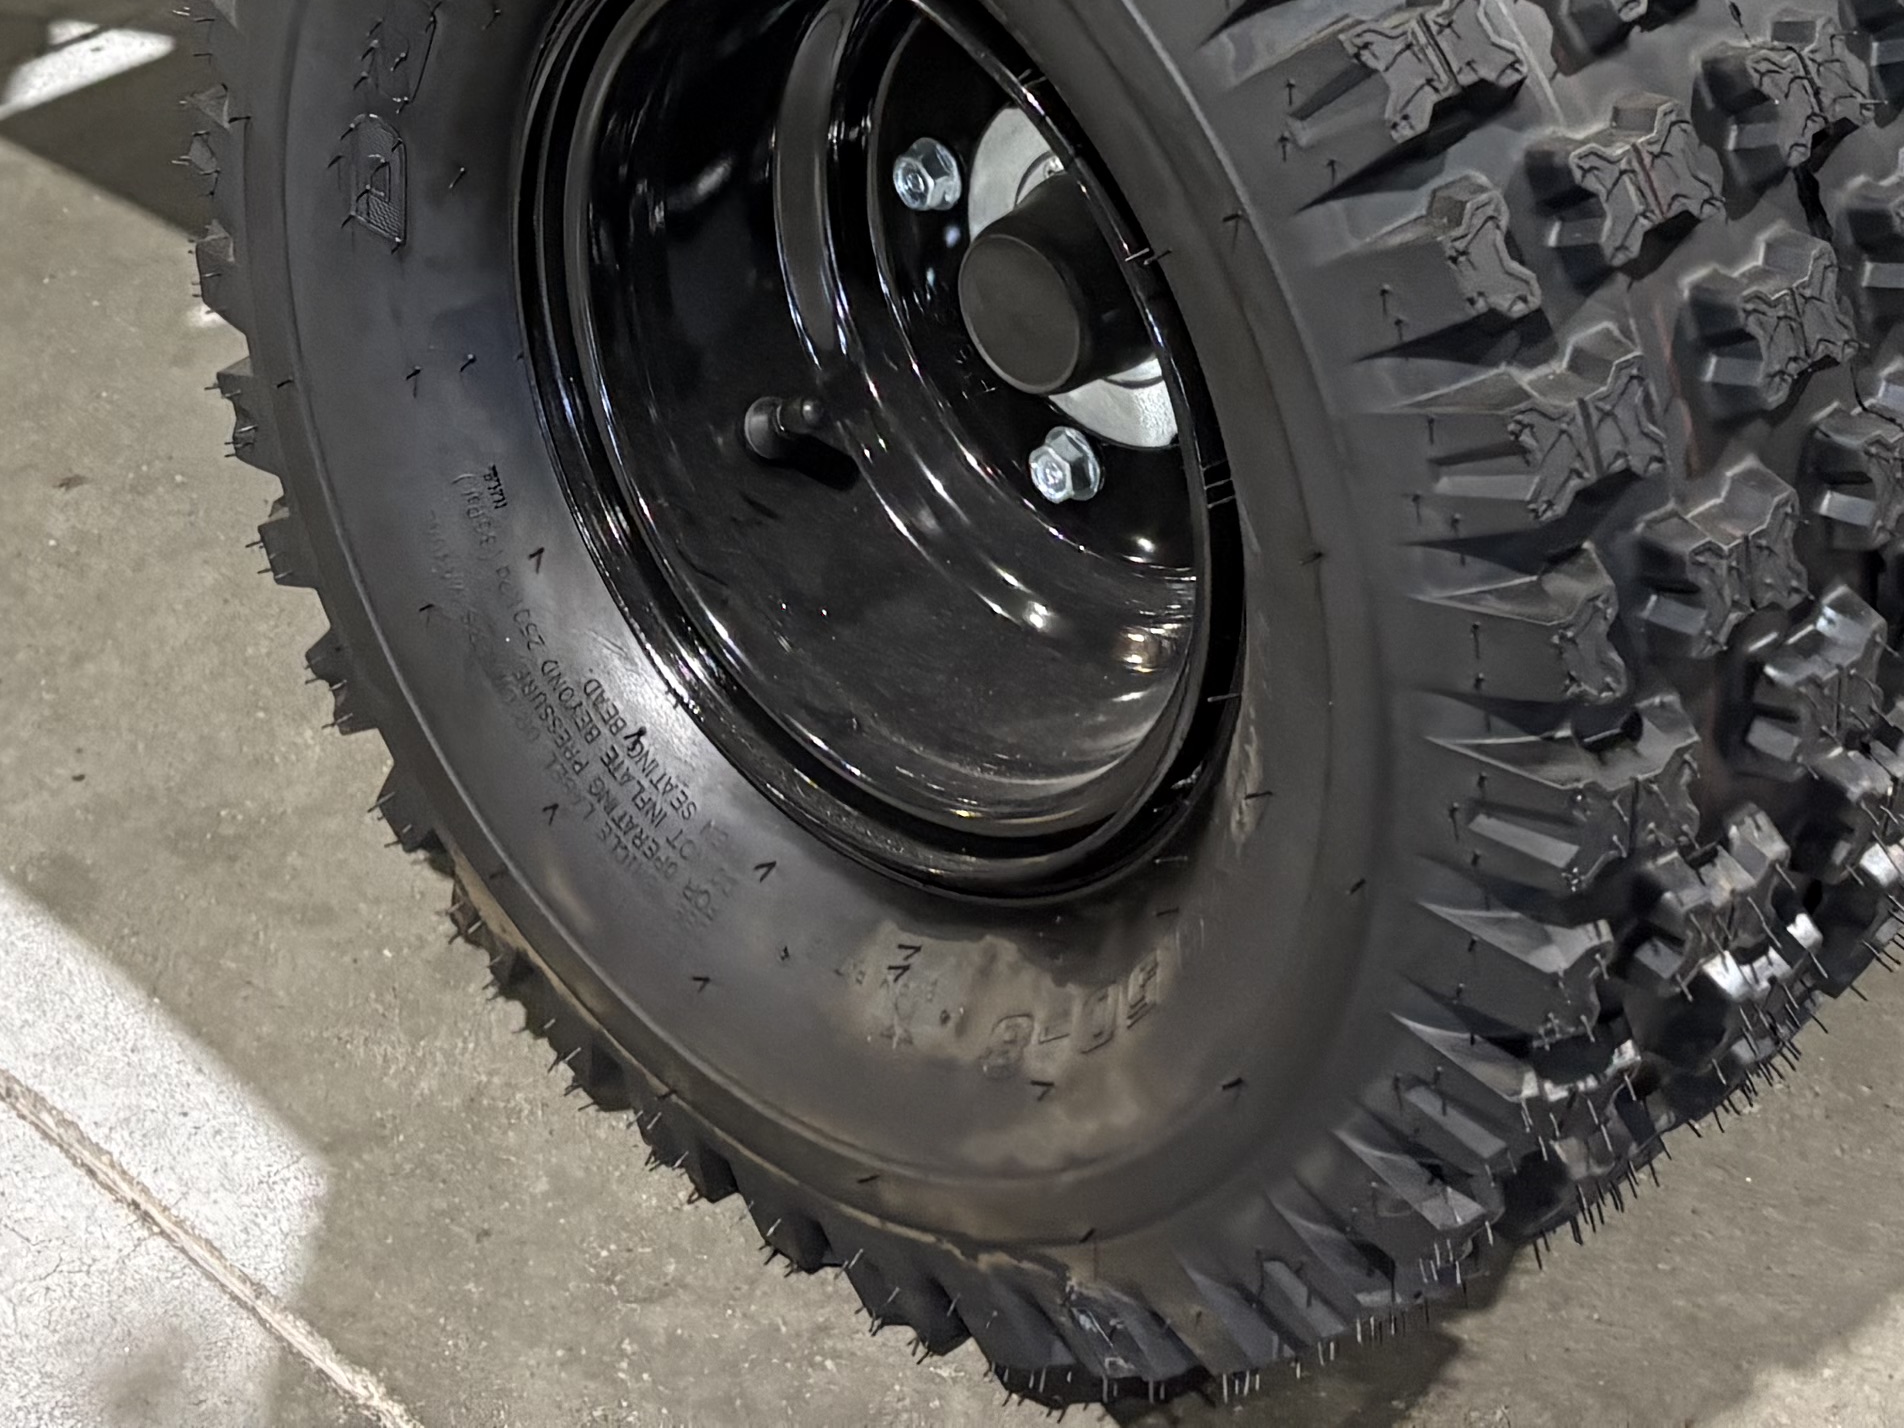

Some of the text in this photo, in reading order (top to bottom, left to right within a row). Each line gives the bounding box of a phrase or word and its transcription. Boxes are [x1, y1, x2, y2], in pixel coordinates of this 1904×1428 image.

[541, 659, 601, 745] BEYOND
[601, 745, 669, 828] INFLATE
[626, 734, 697, 821] SEATING
[591, 780, 679, 878] OPERATING
